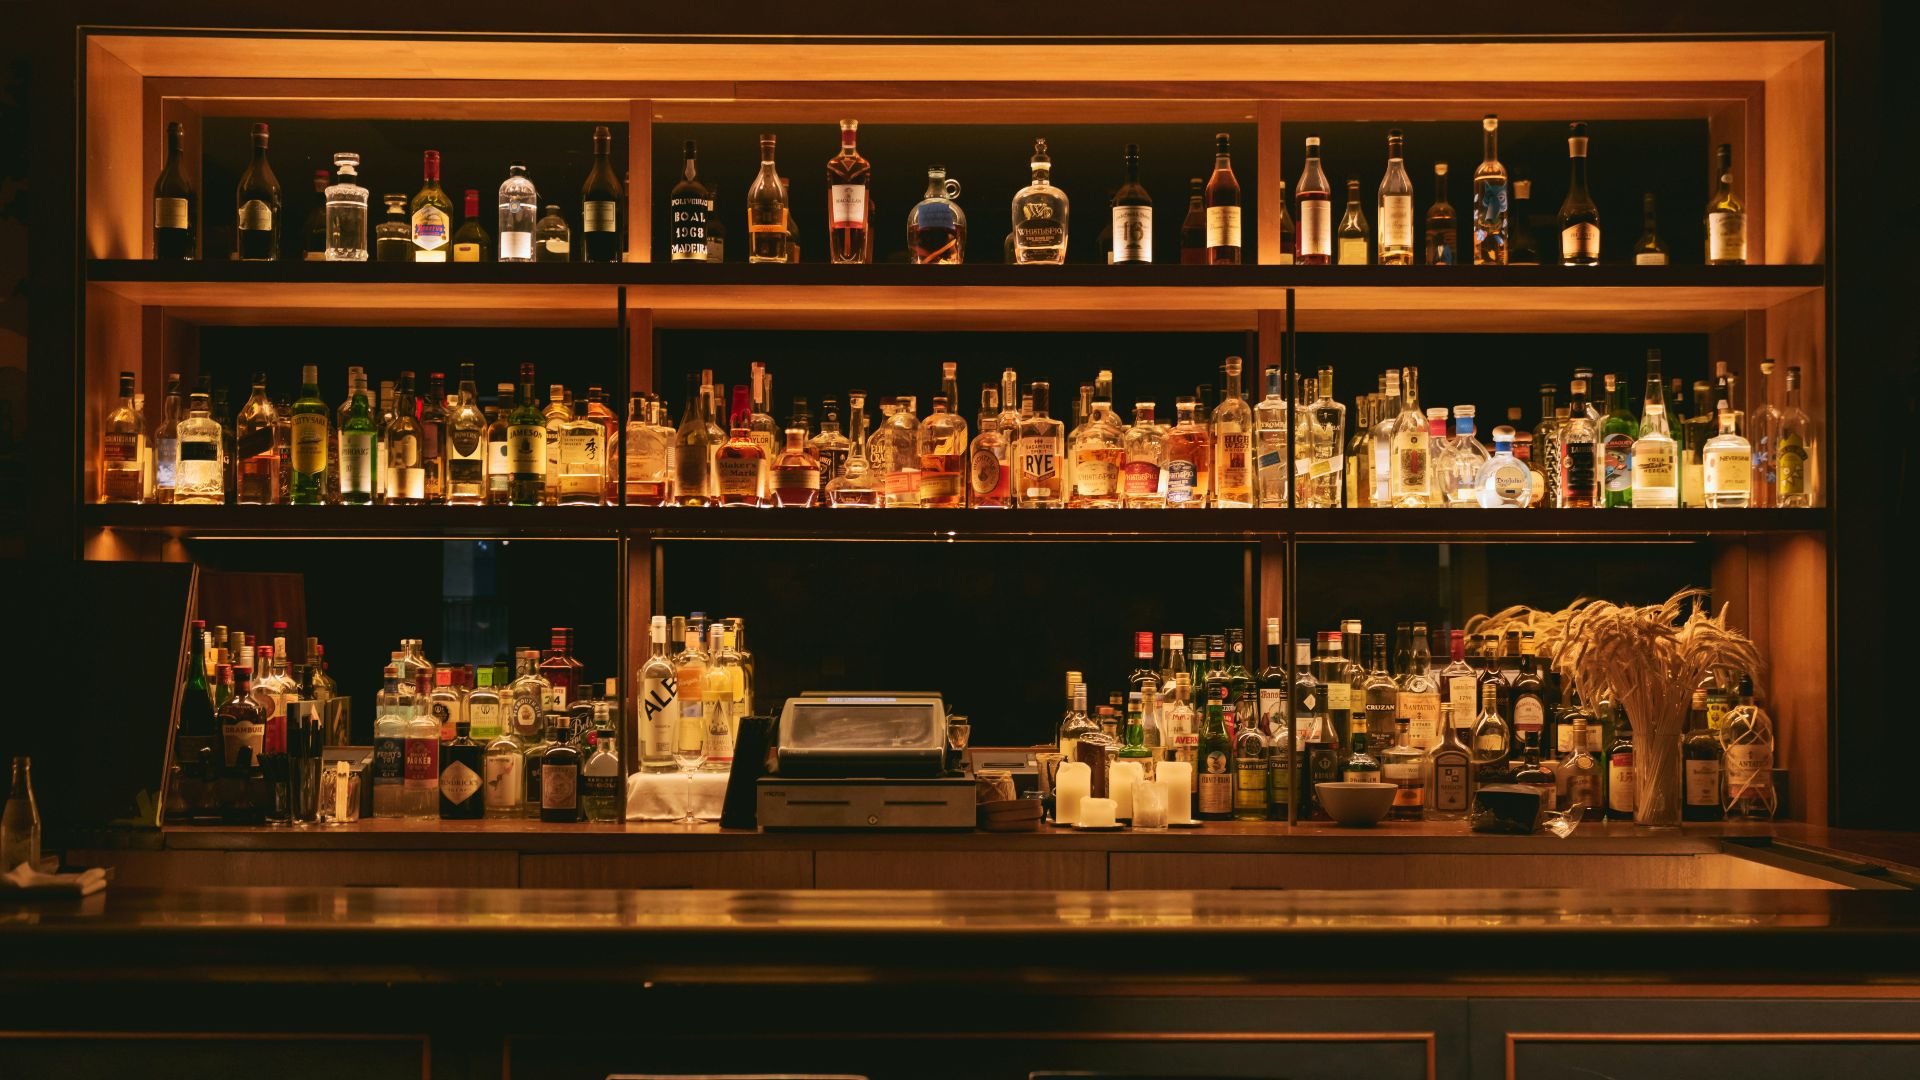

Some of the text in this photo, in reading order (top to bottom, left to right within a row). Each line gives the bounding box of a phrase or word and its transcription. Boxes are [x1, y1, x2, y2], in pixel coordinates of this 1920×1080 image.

[674, 211, 706, 223] BOAL
[675, 227, 704, 239] 1968
[671, 243, 708, 255] MADEIRA
[510, 429, 543, 439] JAMESON
[1224, 434, 1250, 443] HIGH
[1224, 442, 1250, 450] WEST
[1025, 454, 1054, 475] RYE
[730, 469, 757, 477] Mark
[644, 676, 678, 722] ALB
[225, 726, 263, 734] DRAMBUIE
[1174, 736, 1199, 744] AVERN
